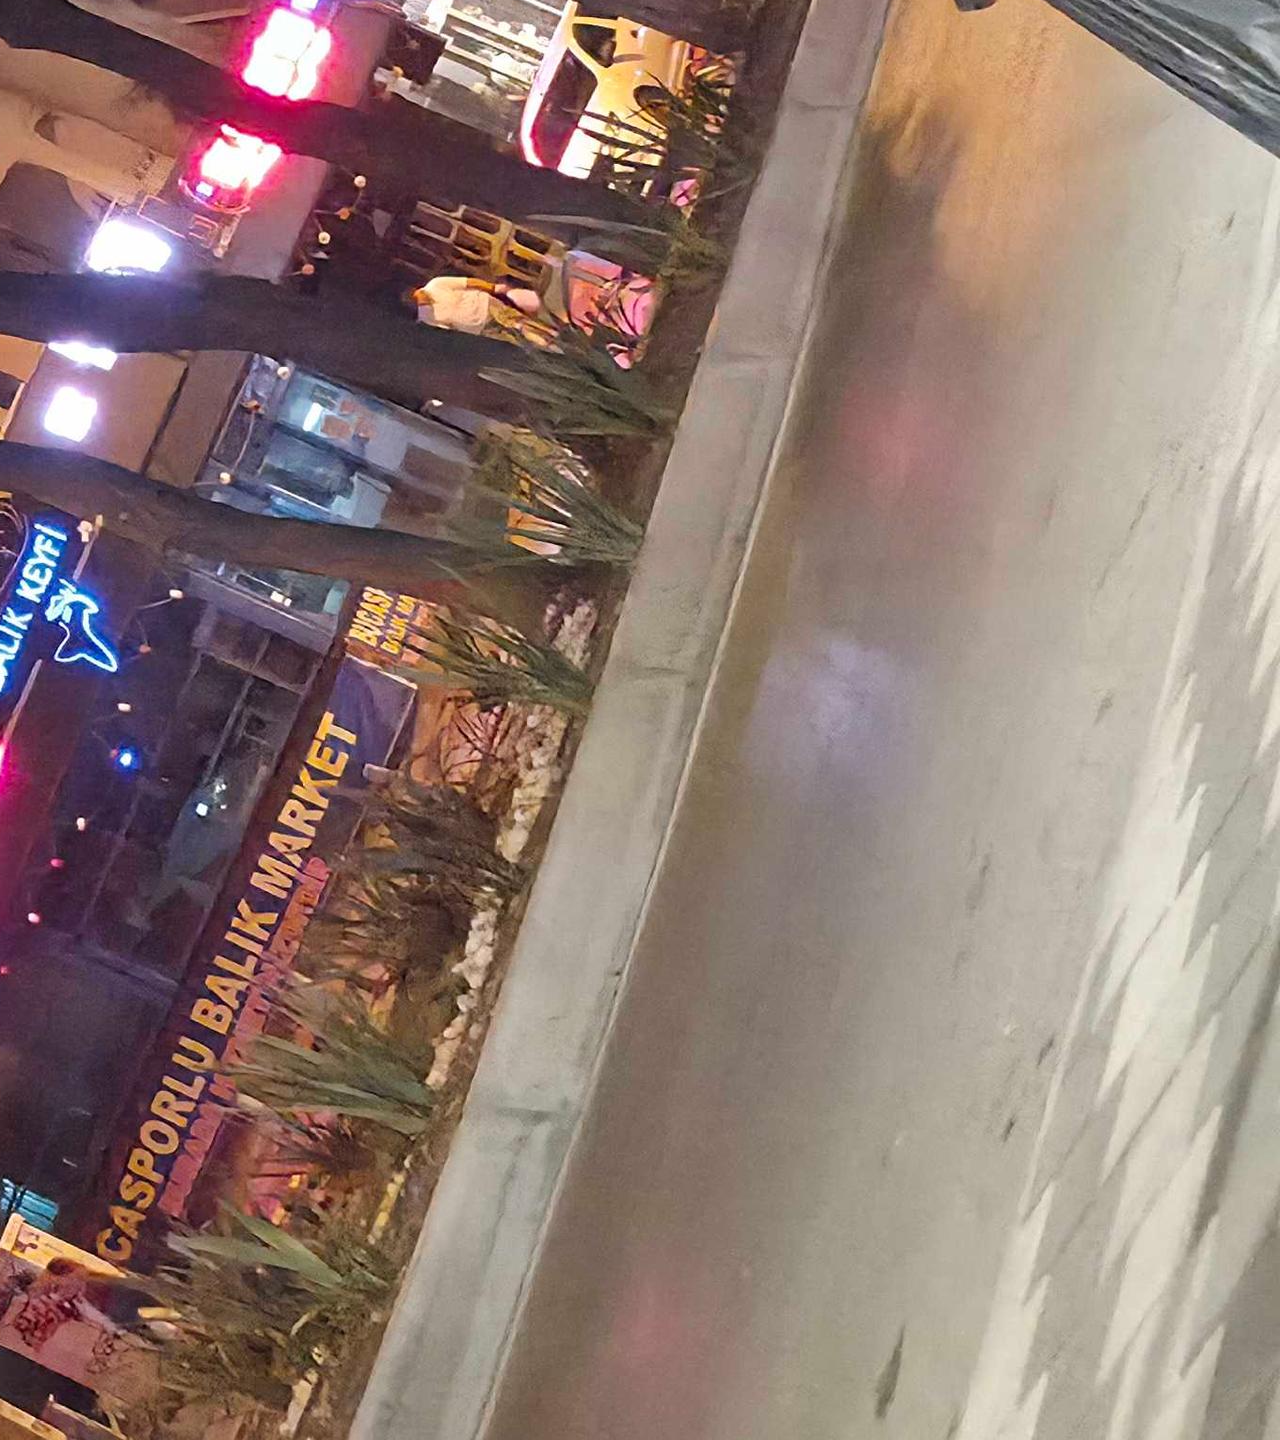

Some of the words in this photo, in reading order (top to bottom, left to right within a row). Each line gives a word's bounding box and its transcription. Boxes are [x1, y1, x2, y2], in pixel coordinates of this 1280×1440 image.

[16, 524, 67, 603] KEYFİ
[190, 898, 279, 1033] BALIK
[251, 709, 361, 898] MARKET
